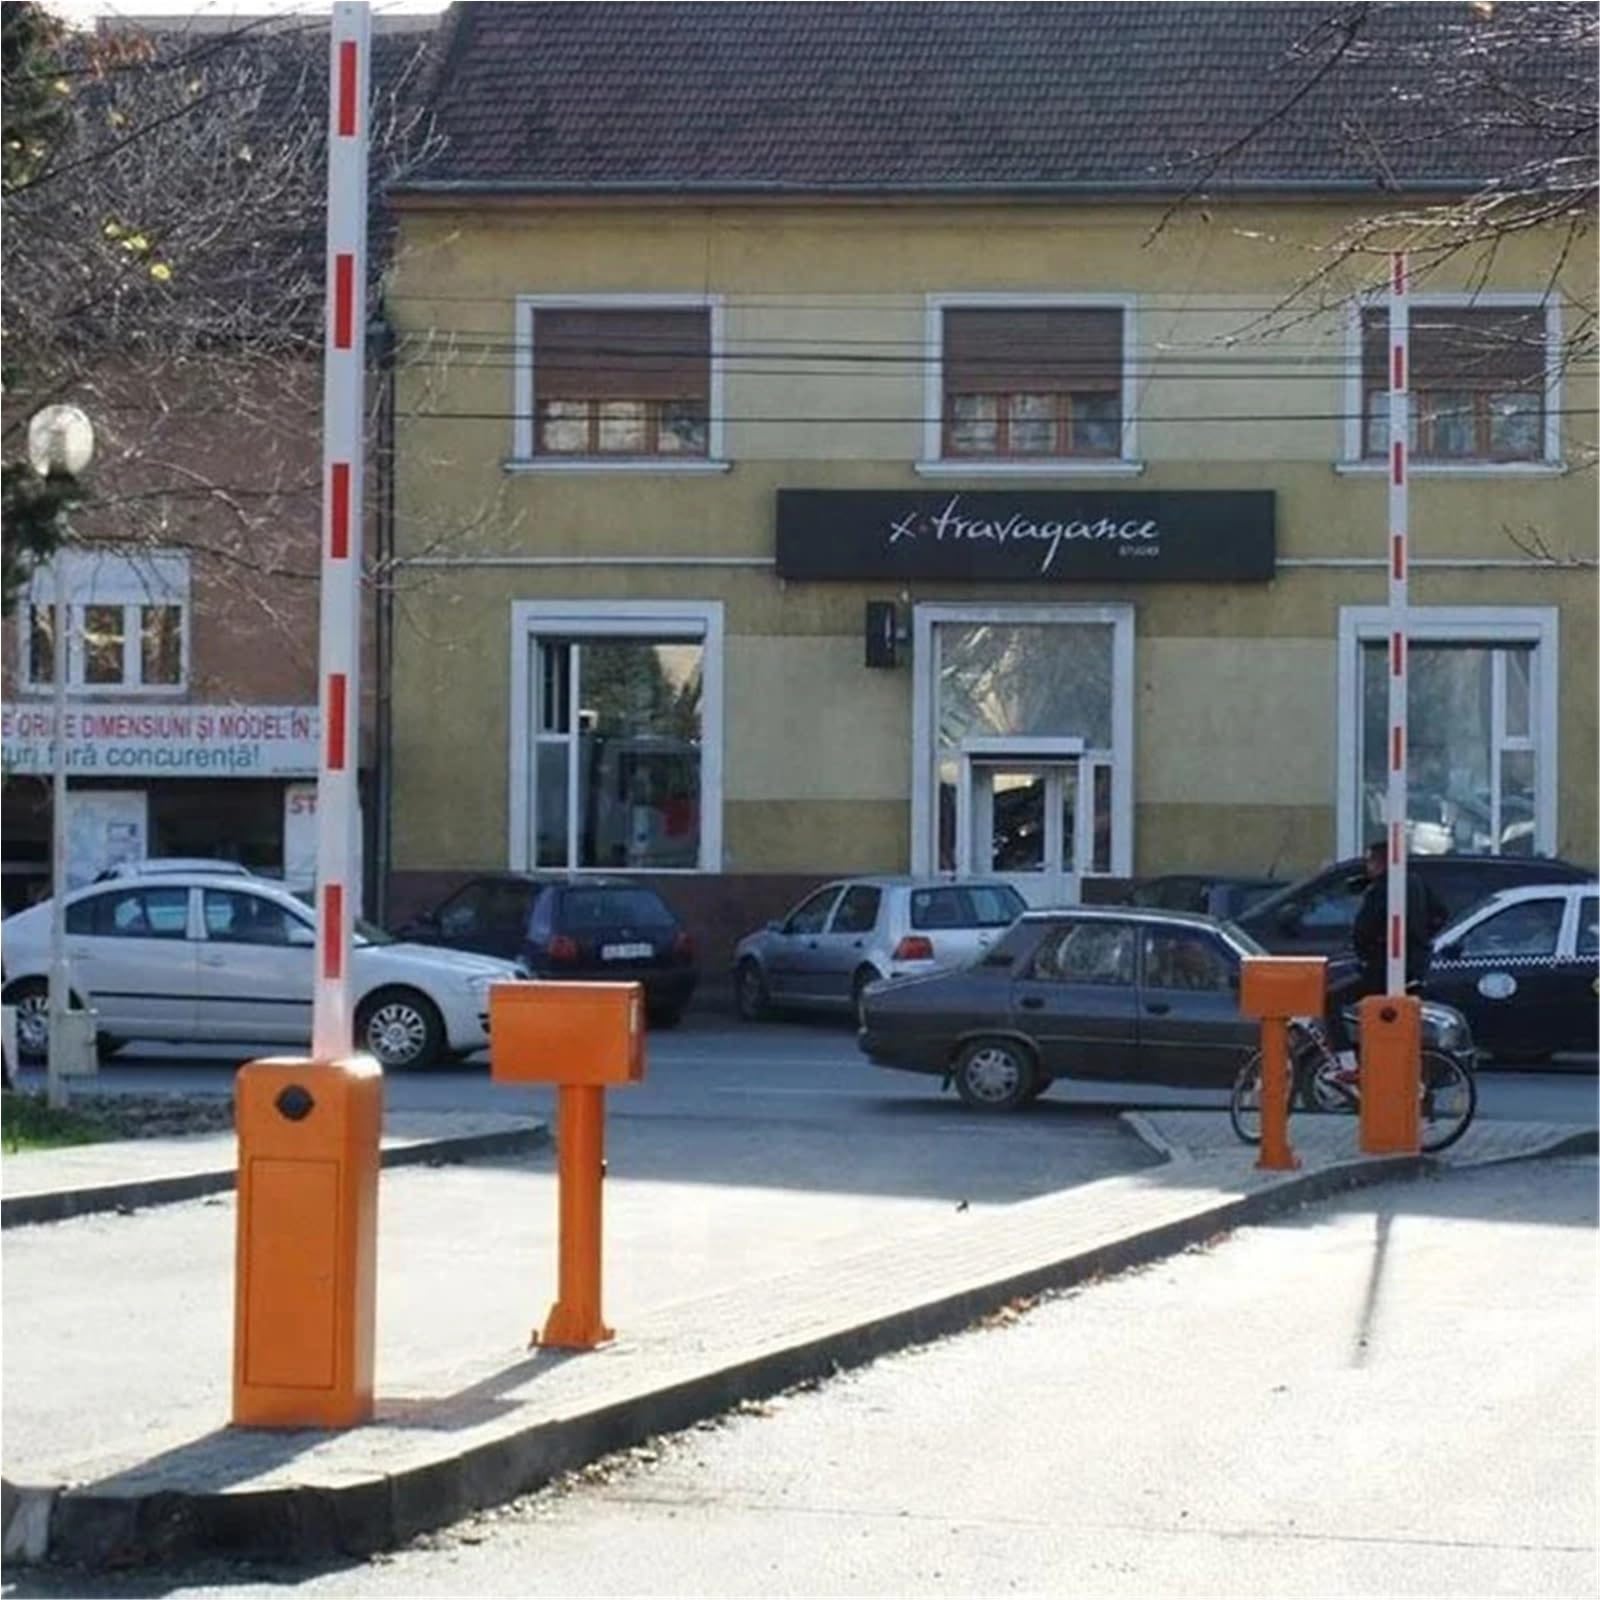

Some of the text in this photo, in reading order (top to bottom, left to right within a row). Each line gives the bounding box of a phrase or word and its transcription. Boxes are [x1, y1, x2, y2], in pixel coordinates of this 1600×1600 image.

[18, 714, 76, 739] ORIE
[82, 714, 193, 739] DIMENSIUNI
[219, 714, 286, 740] MODEL
[2, 743, 38, 767] uri
[48, 743, 97, 767] fră
